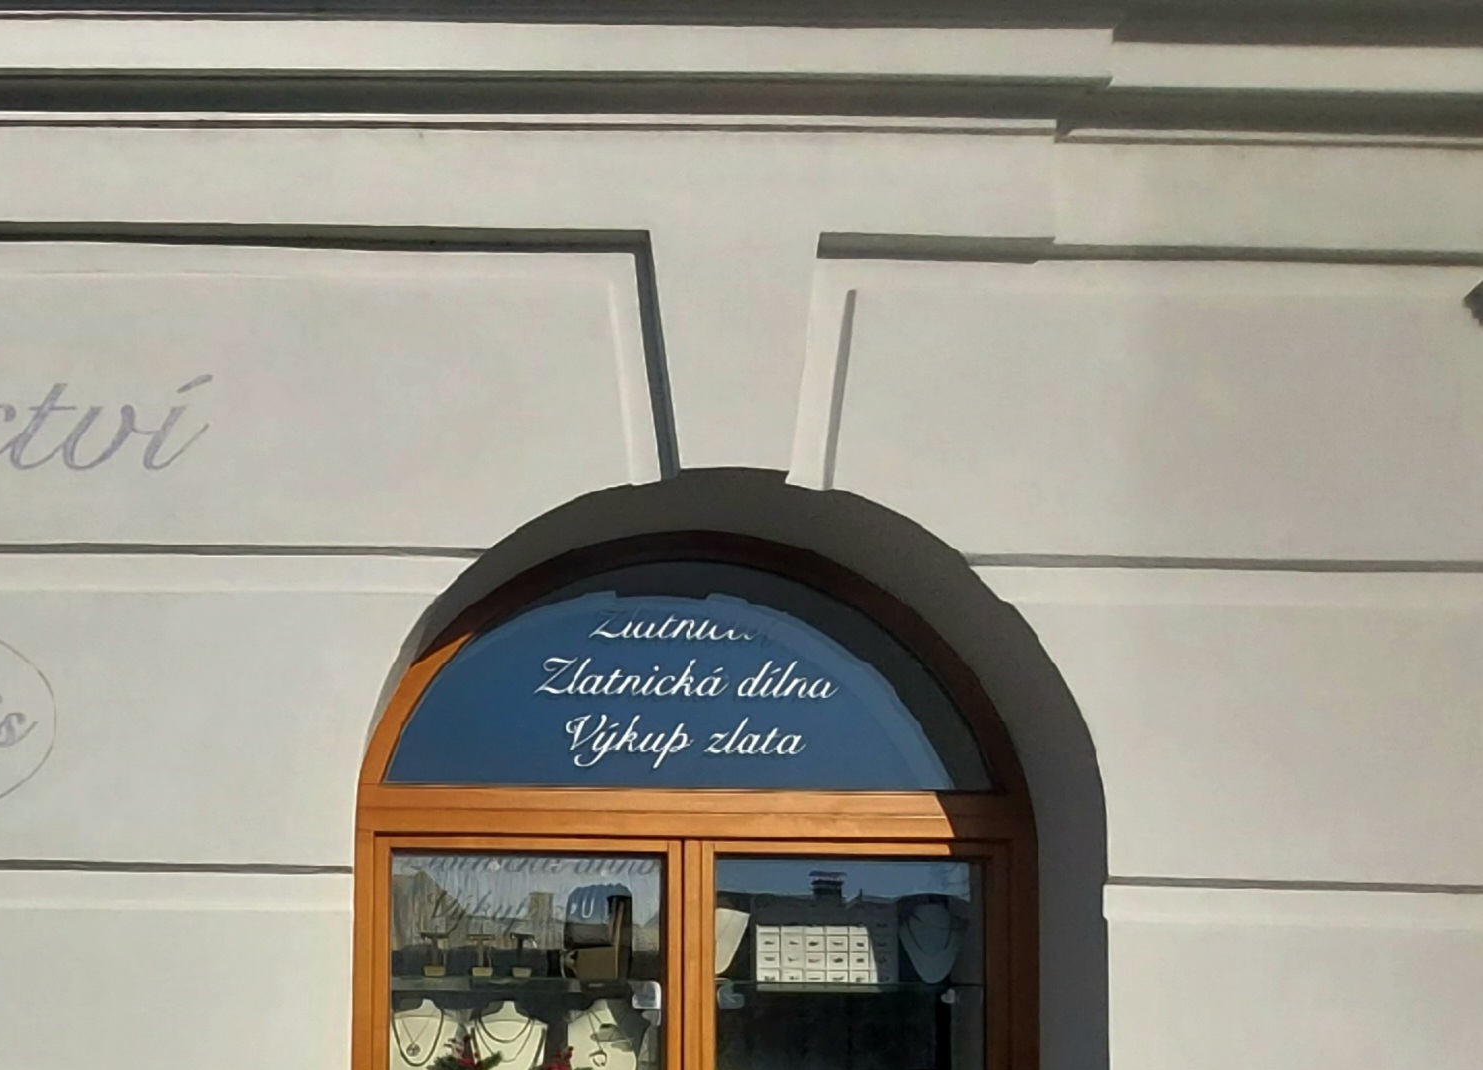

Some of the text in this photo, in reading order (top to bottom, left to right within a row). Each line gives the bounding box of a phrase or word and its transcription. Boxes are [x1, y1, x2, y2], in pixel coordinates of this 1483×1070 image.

[533, 656, 839, 699] Zlatnická dílna
[565, 714, 808, 769] Výkup zlata
